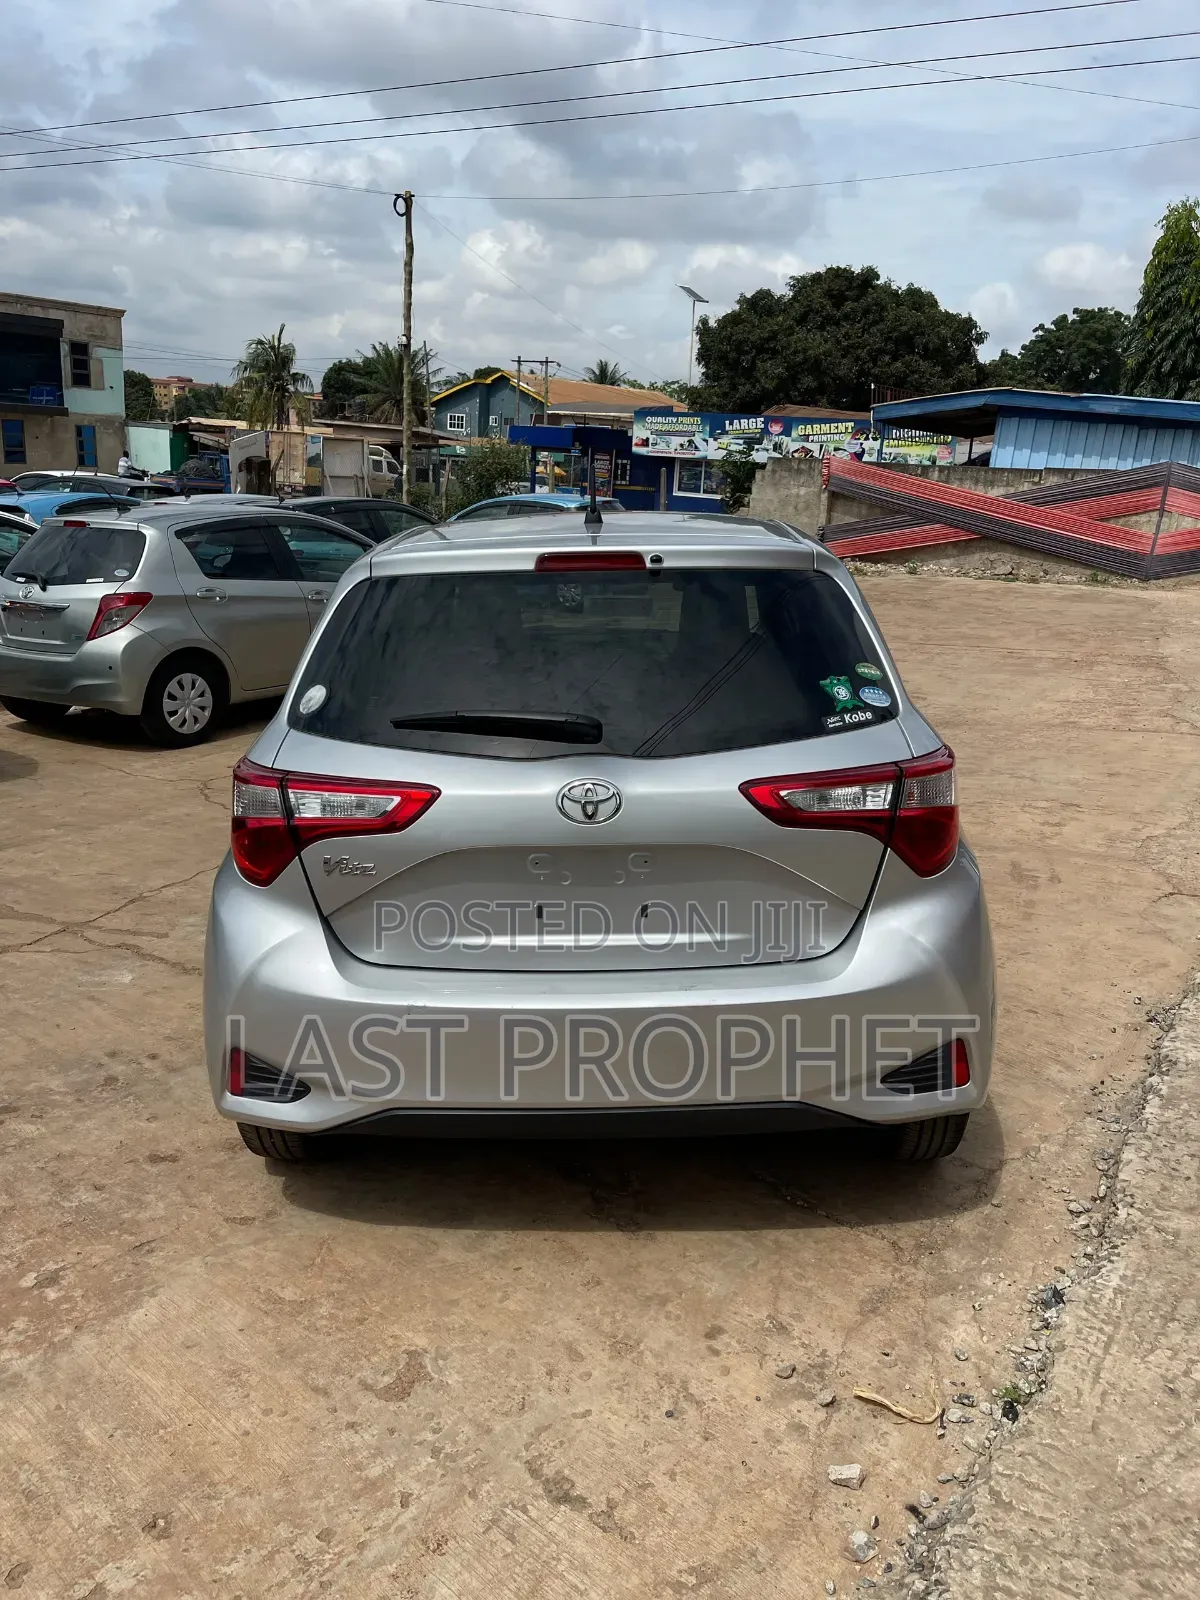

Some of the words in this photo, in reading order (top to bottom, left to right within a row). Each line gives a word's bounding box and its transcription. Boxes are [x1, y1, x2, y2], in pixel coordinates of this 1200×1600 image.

[678, 416, 701, 424] PRINTS
[725, 417, 765, 431] LARGE
[645, 423, 665, 431] MADE
[665, 424, 703, 432] AFFORDABLE
[797, 421, 855, 436] GARMENT
[808, 433, 846, 443] PRINTING
[844, 710, 872, 724] Kobe
[323, 855, 377, 877] Vitz
